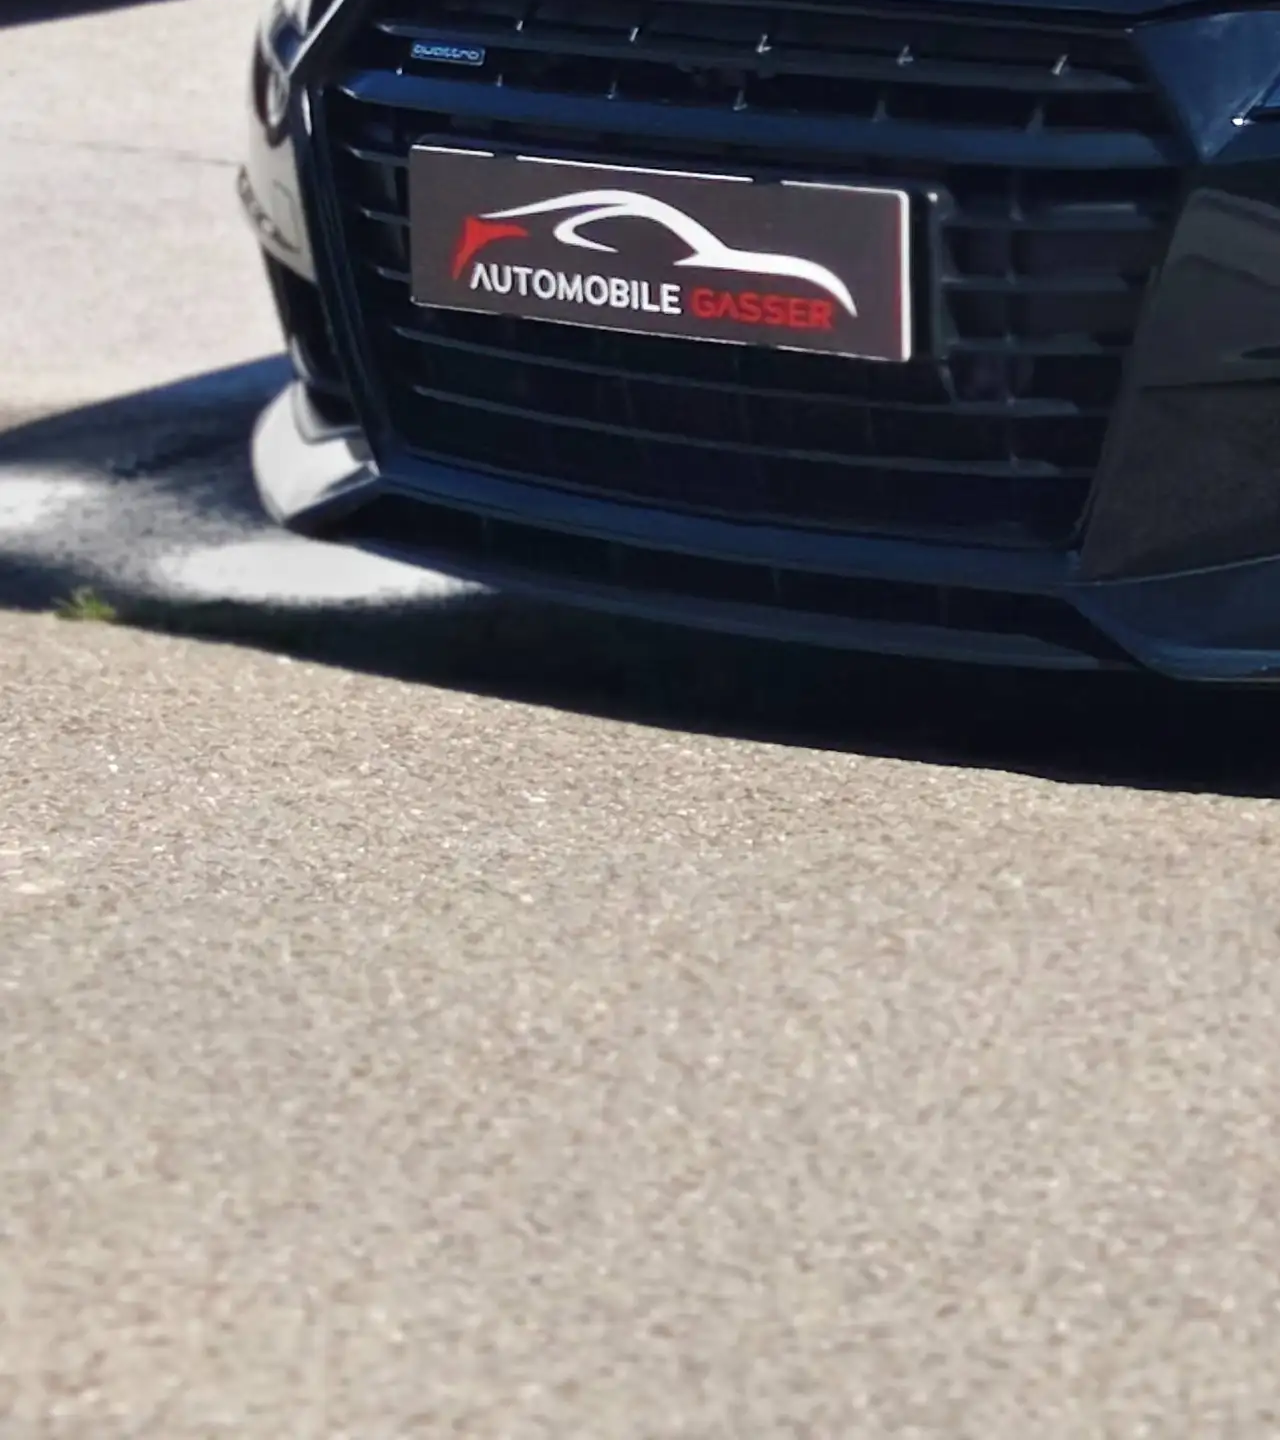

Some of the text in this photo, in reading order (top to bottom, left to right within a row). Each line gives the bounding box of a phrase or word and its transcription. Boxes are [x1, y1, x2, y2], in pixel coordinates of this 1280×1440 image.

[413, 44, 480, 60] quattro
[470, 262, 834, 329] AUTOMOBILE GASSER
